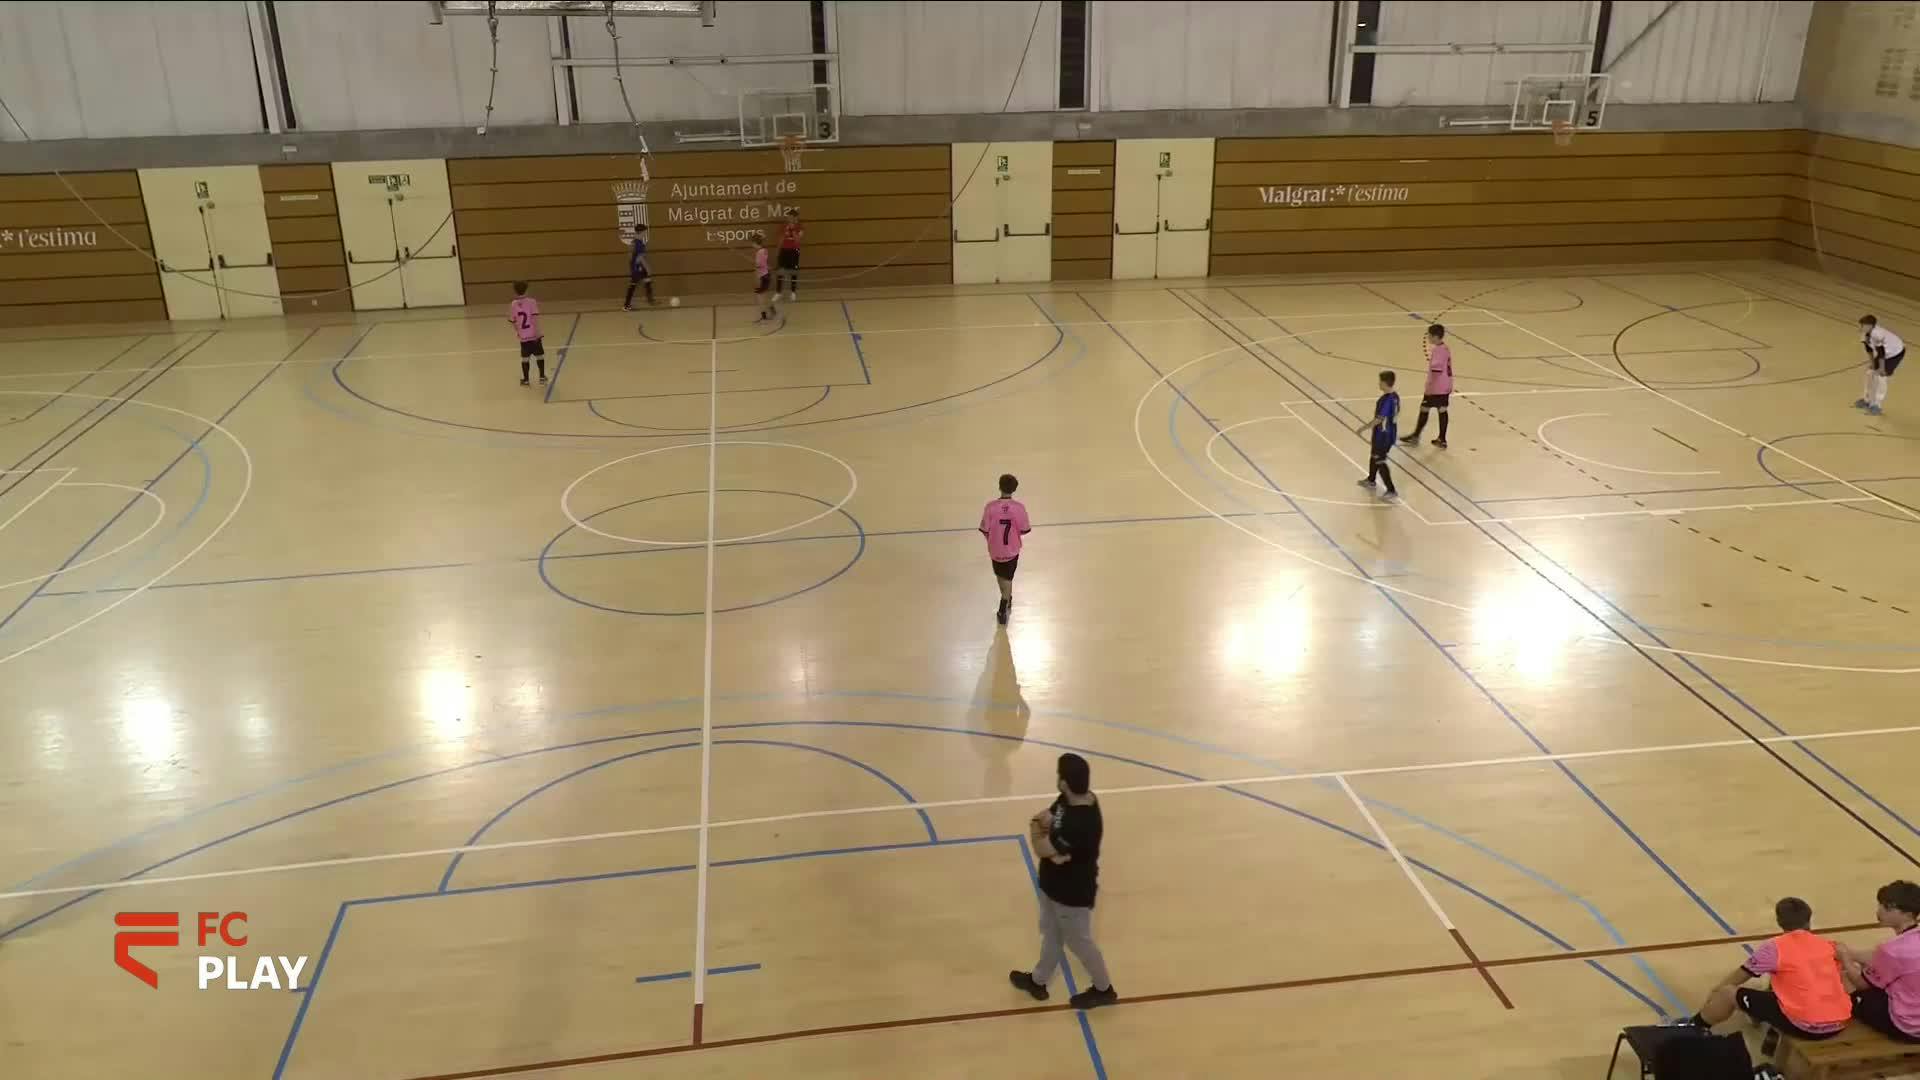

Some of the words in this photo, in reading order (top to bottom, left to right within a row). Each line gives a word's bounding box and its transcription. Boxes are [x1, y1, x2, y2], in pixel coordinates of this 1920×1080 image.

[1586, 111, 1599, 127] 5
[819, 122, 831, 139] 3
[671, 182, 769, 200] Ajuntament
[776, 179, 797, 194] de
[668, 208, 733, 225] Malgrat
[739, 205, 761, 220] de
[518, 311, 531, 330] 2
[999, 518, 1012, 546] 7
